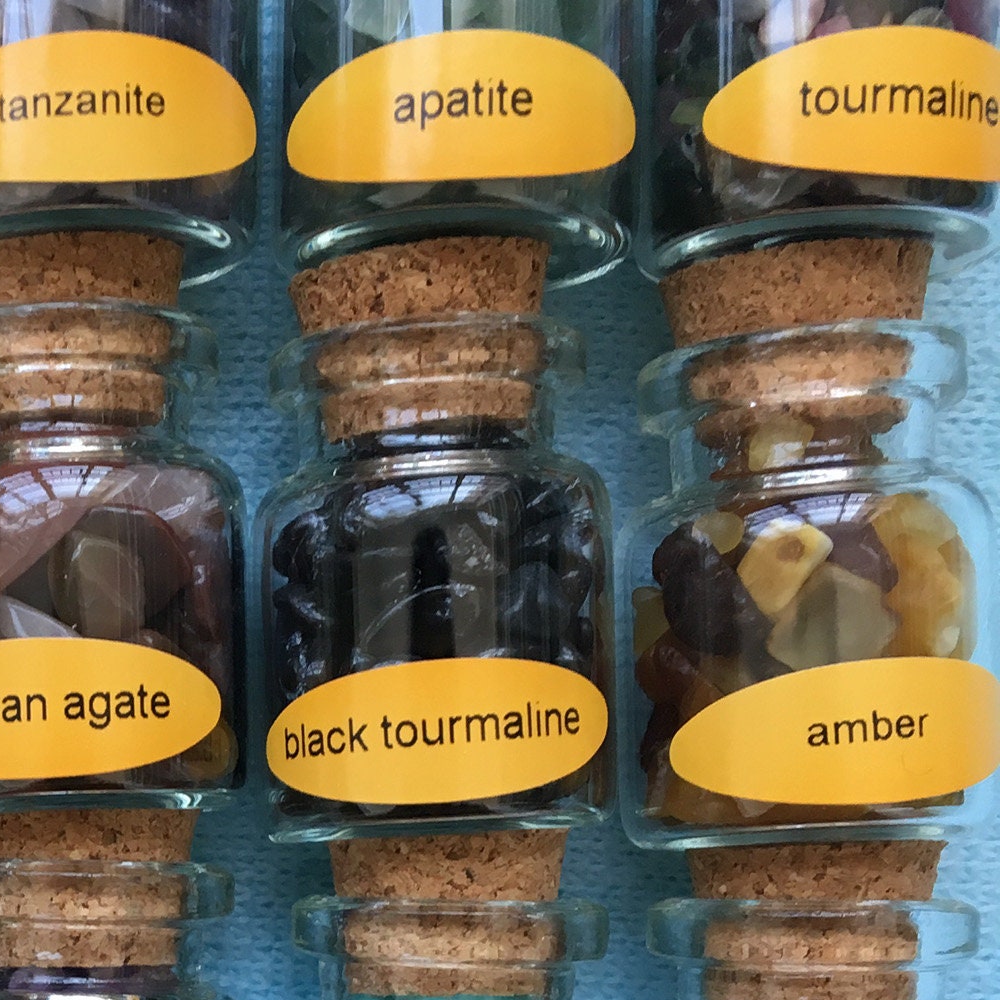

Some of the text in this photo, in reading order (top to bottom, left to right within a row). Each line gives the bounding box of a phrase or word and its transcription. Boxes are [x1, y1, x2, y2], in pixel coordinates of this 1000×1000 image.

[0, 85, 165, 119] tanzanite
[393, 81, 533, 128] apatite
[801, 79, 1000, 126] tourmaline
[64, 684, 171, 730] agate
[284, 700, 580, 760] black tourmaline
[807, 710, 928, 747] amber
